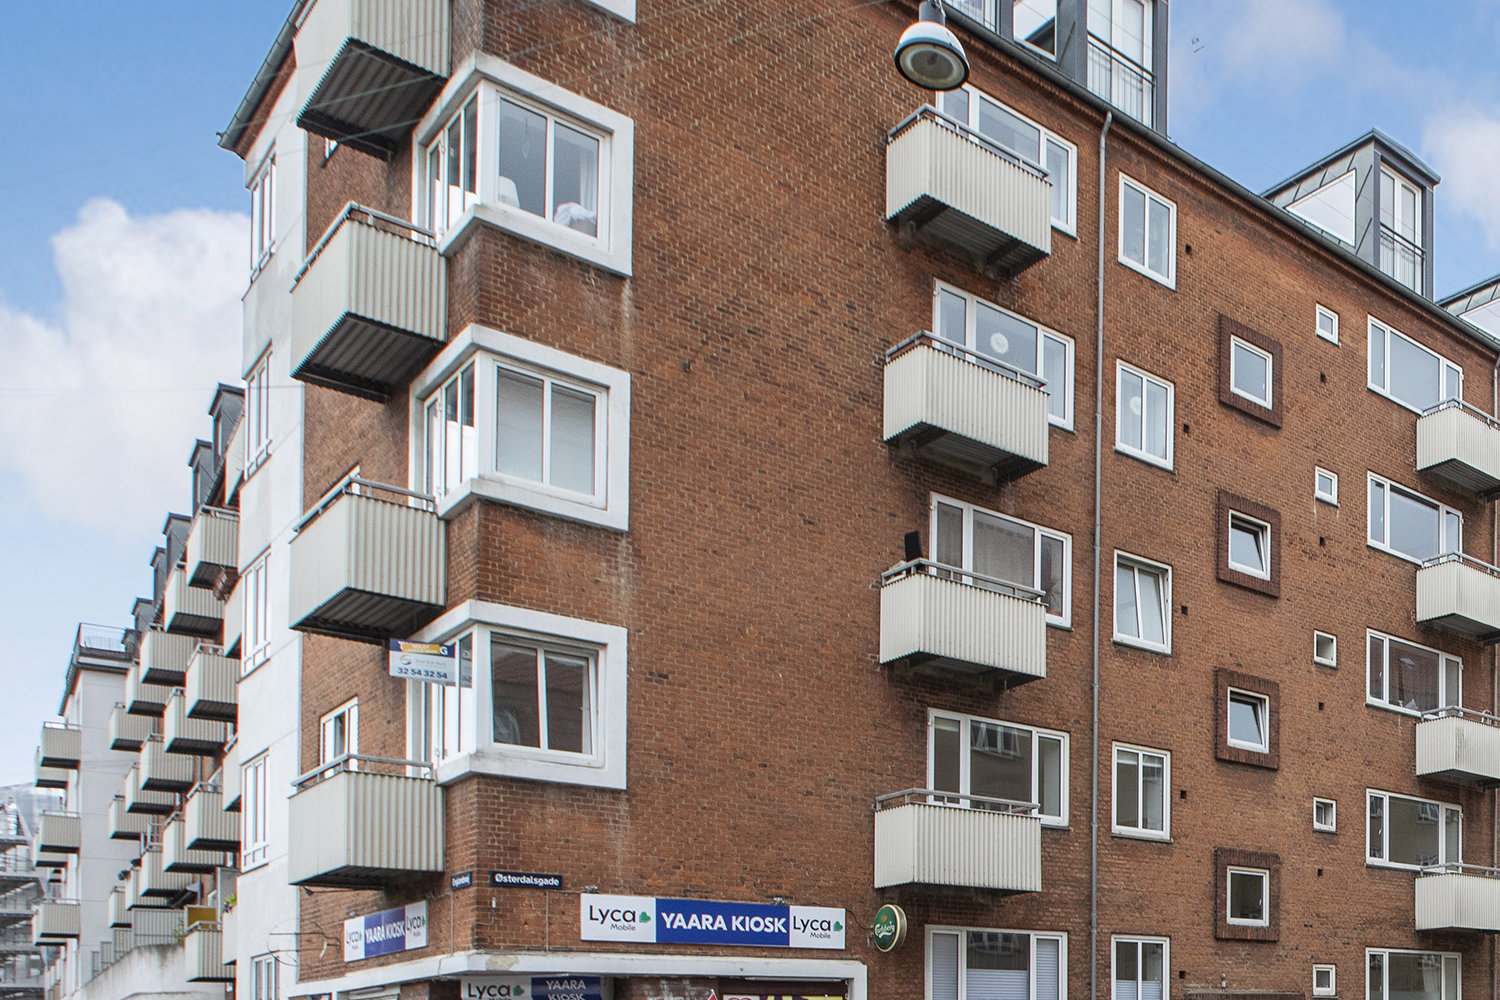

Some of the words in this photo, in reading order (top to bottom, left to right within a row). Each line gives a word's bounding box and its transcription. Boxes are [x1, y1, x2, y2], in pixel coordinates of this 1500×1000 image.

[397, 667, 409, 675] 32
[410, 668, 422, 676] 54
[436, 671, 448, 679] 54
[495, 873, 560, 887] Østerdalsgade
[589, 905, 636, 926] Lyca
[661, 912, 727, 931] YAARA
[732, 915, 787, 934] KIOSK
[793, 914, 831, 933] Lyca
[365, 924, 386, 944] YAARA
[386, 920, 405, 938] KIOSK
[406, 915, 421, 934] Lyca
[610, 923, 636, 932] Mobile
[874, 921, 895, 938] Carlsberg
[346, 930, 359, 945] Lyca
[810, 931, 831, 939] Mobile
[468, 983, 511, 1000] Lyca
[546, 980, 586, 990] YAARA
